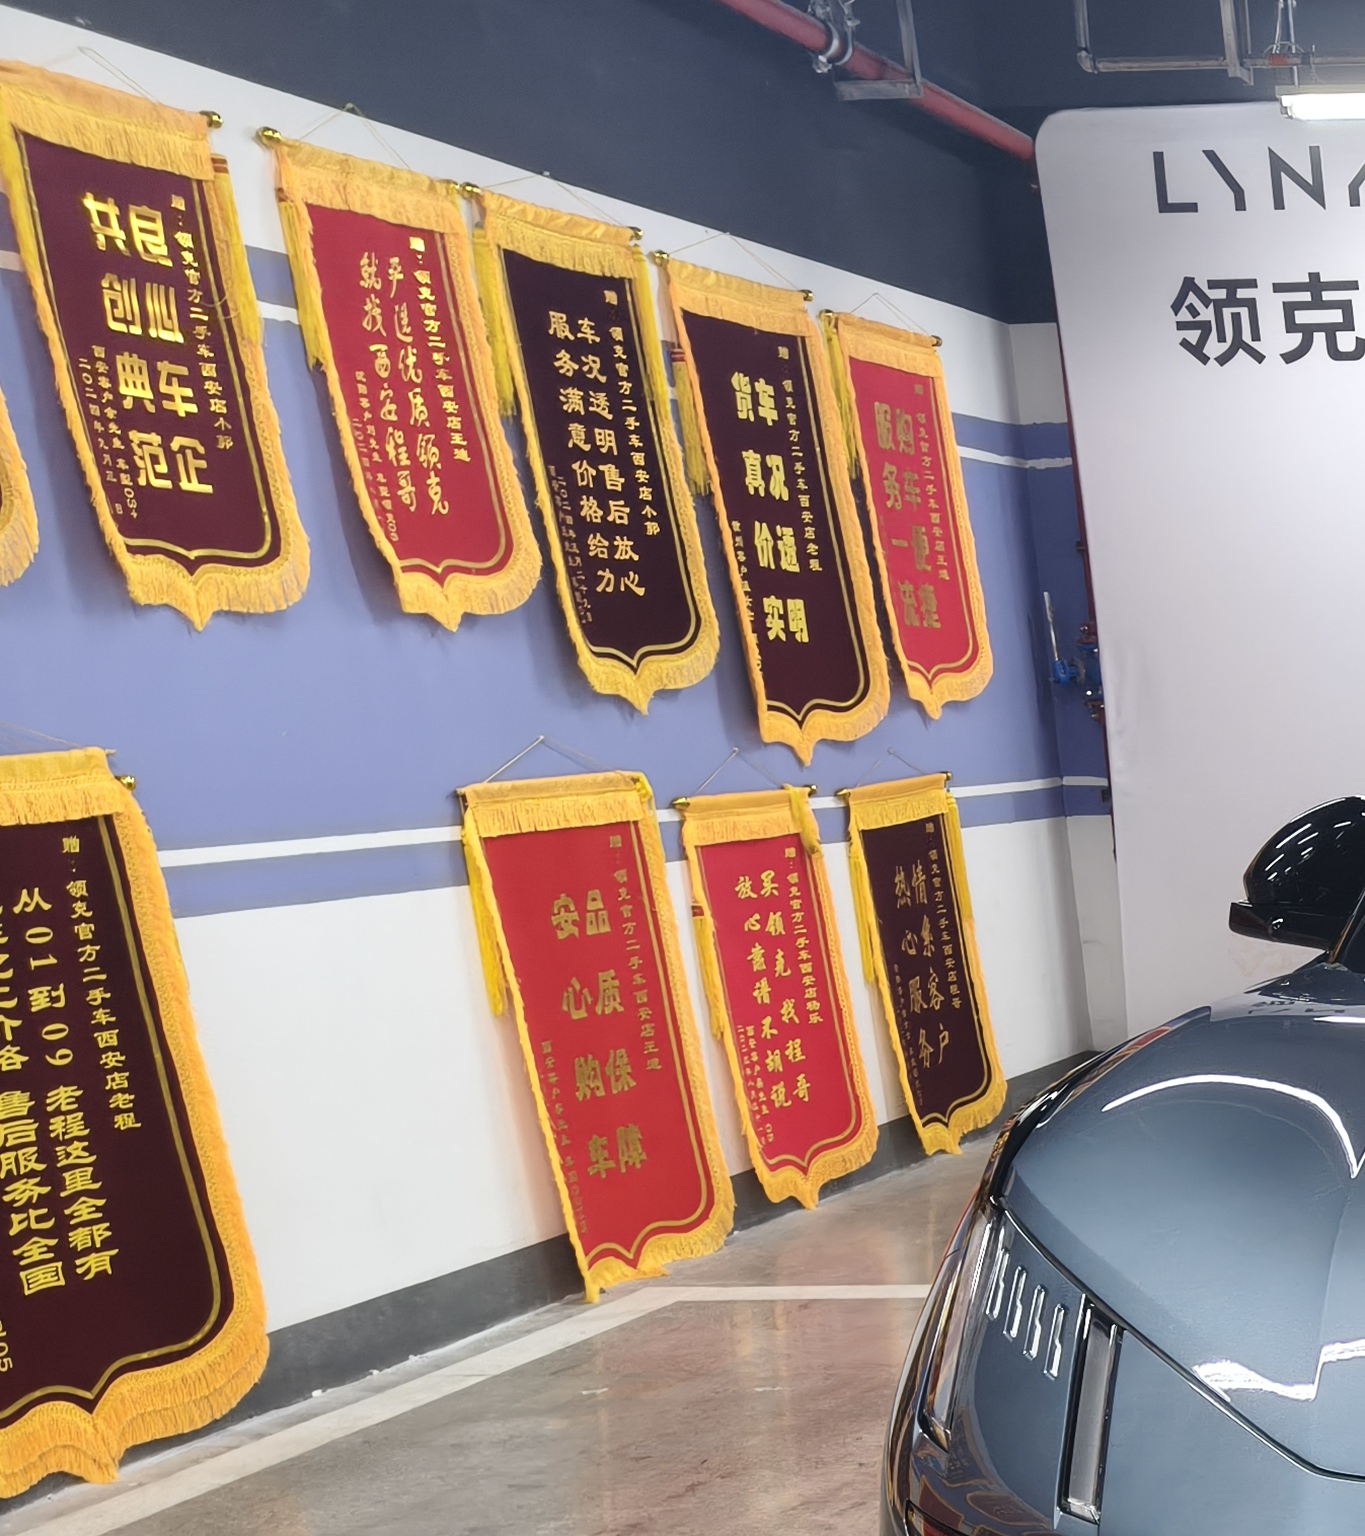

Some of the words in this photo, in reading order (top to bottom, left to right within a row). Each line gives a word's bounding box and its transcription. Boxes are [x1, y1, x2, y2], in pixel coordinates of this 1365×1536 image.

[82, 192, 173, 490] 共创典范
[359, 252, 417, 512] 就找西安程哥
[548, 311, 615, 593] 服务满意价格给力
[576, 317, 646, 597] 车况透明售后放心
[731, 371, 787, 642] 货真价实
[551, 893, 616, 1179] 安心购车
[586, 889, 648, 1173] 品质保障
[734, 875, 792, 1109] 放心靠谱不胡说
